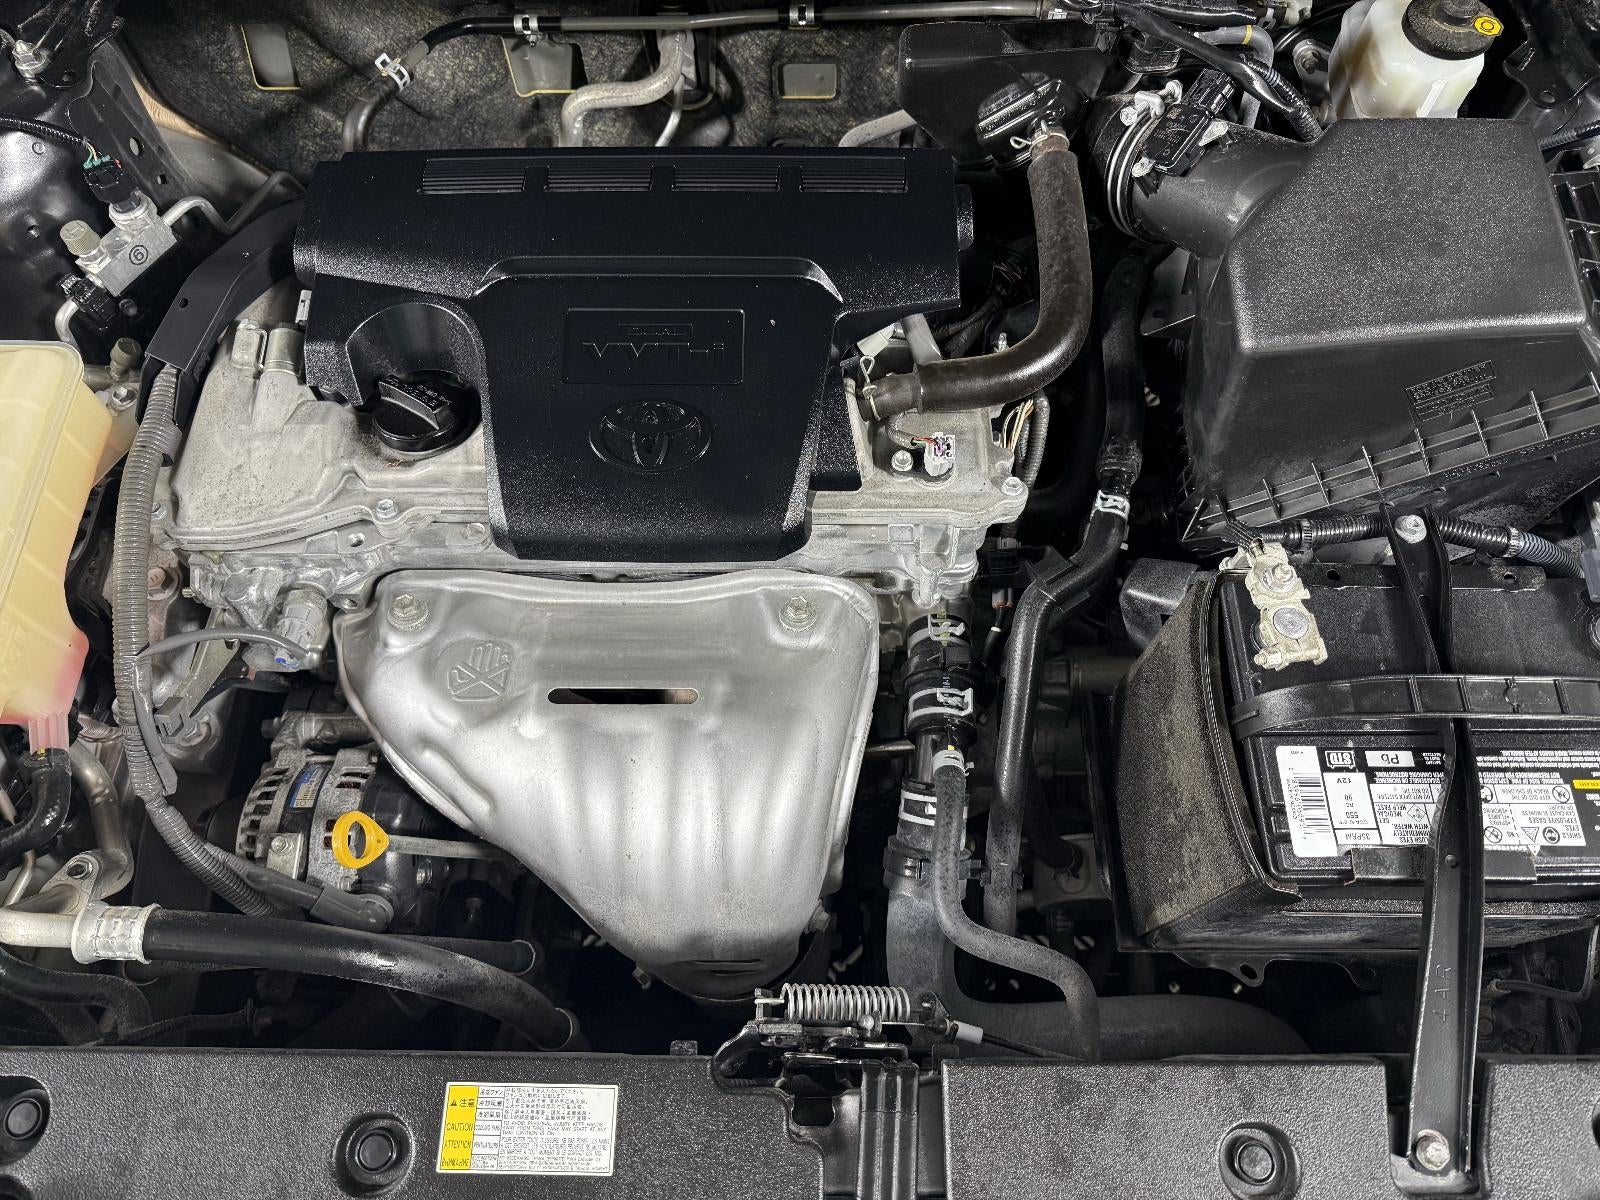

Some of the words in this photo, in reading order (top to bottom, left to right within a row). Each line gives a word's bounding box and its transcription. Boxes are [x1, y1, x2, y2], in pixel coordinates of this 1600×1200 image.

[1330, 752, 1351, 764] STD
[1381, 754, 1399, 765] Pb
[446, 1122, 473, 1132] CAUTION
[444, 1140, 471, 1148] ATTENTION
